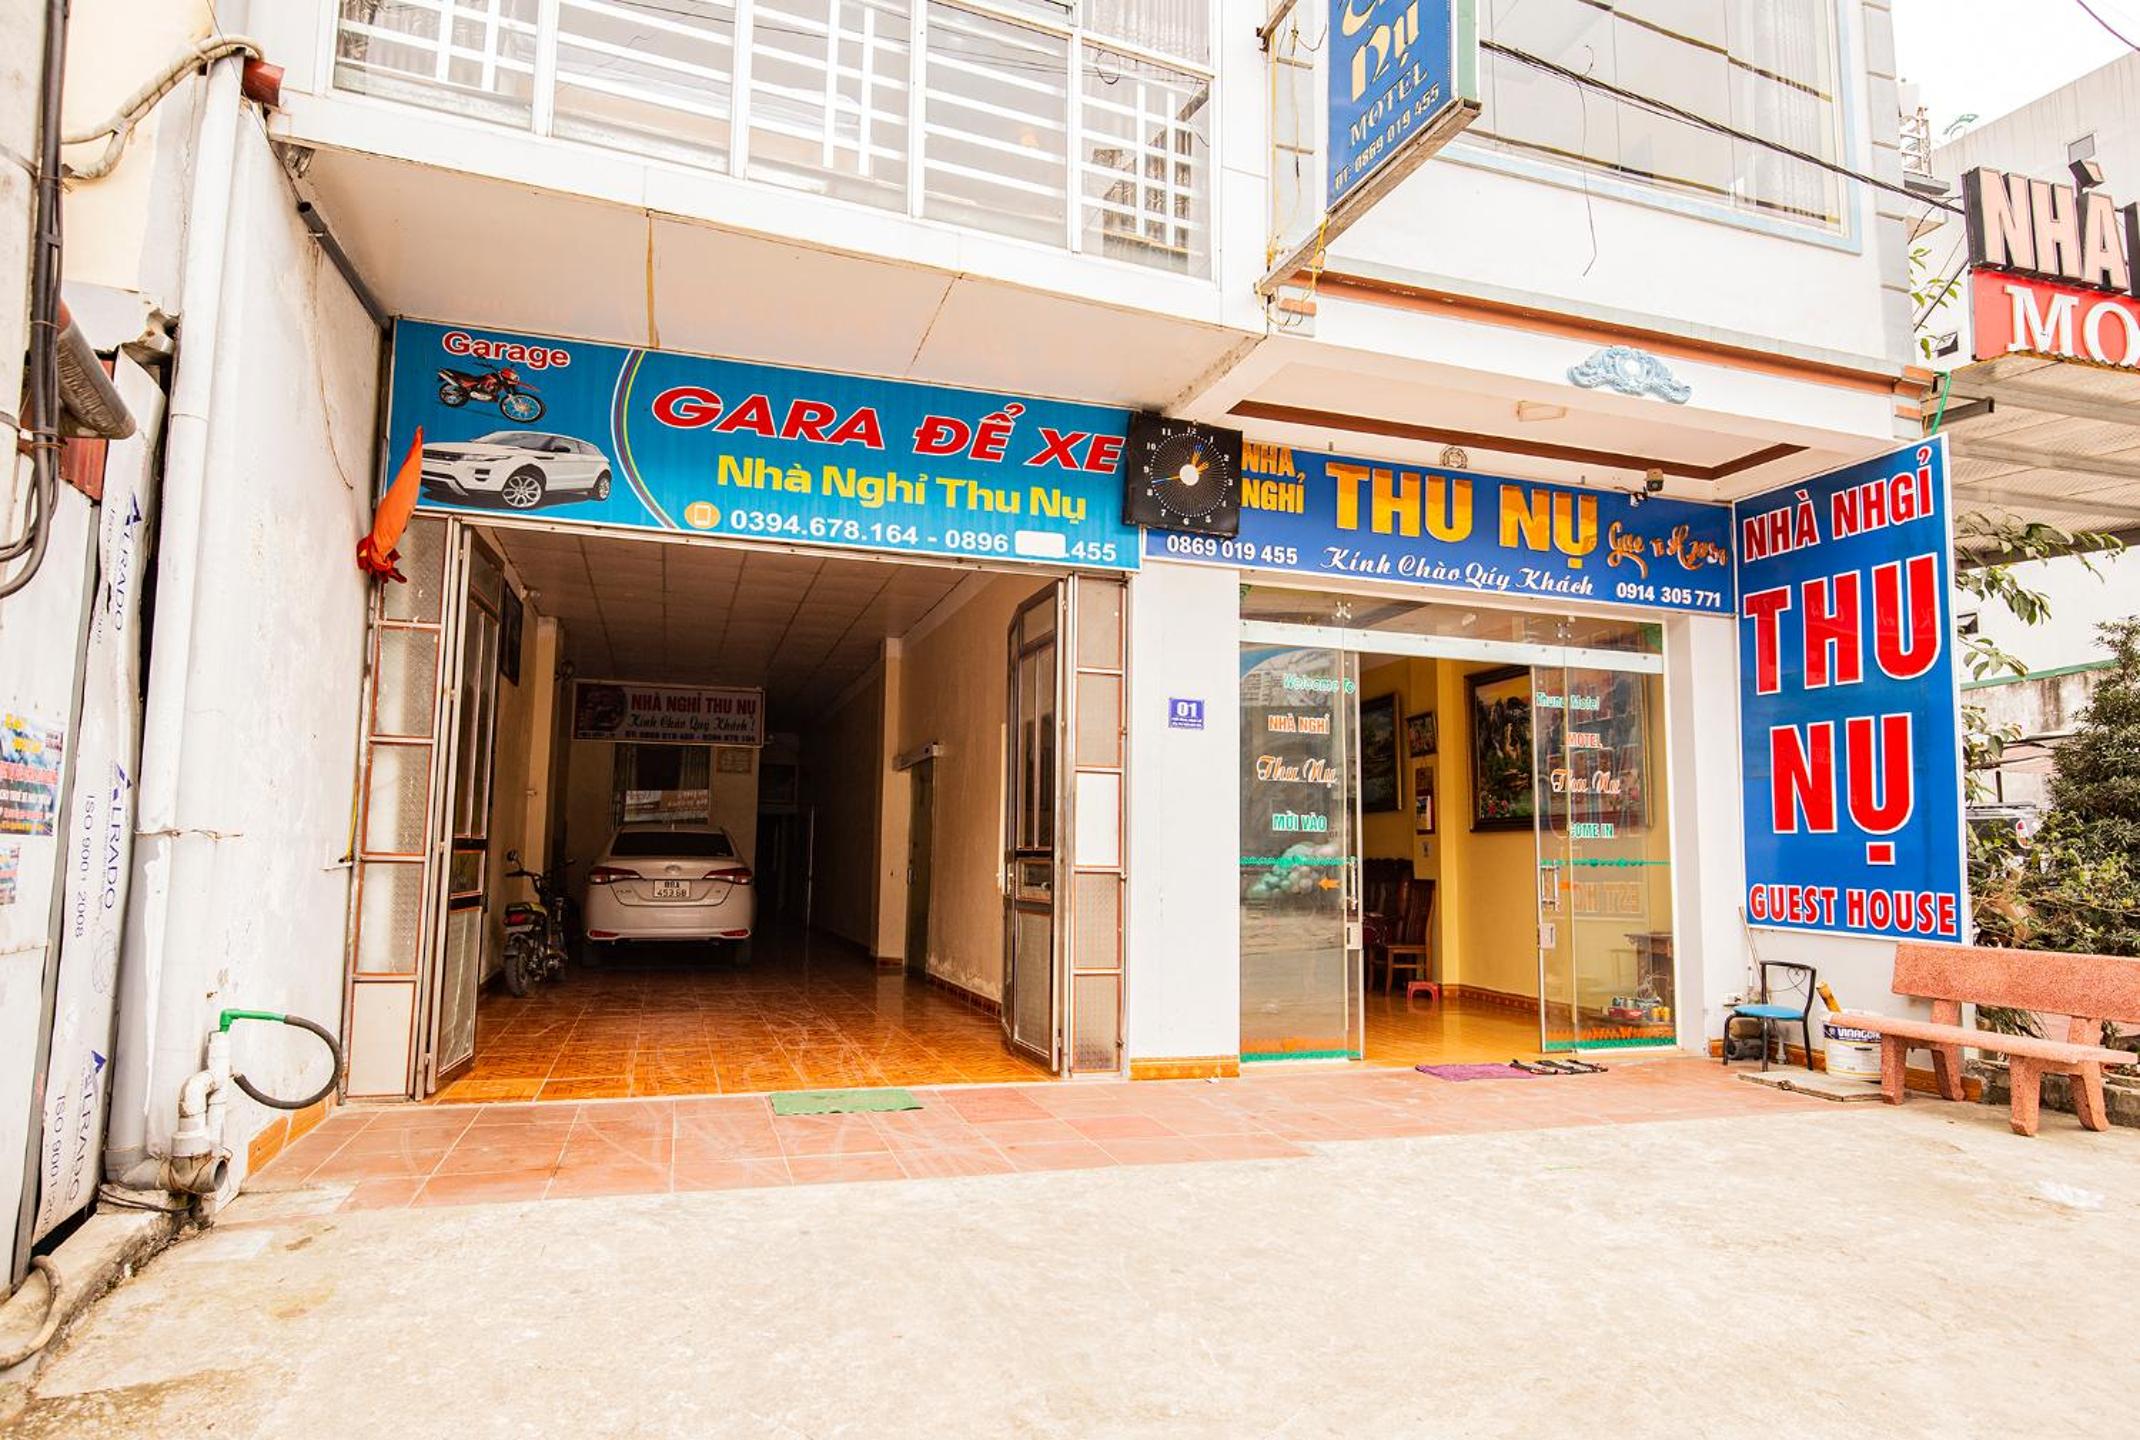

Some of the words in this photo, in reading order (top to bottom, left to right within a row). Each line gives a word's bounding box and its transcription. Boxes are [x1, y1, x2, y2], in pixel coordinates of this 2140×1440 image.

[1349, 60, 1428, 147] MOTEL
[1354, 134, 1384, 173] 0869
[1386, 109, 1411, 144] 019
[1413, 82, 1440, 116] 455
[1963, 159, 2130, 291] NHÀ
[442, 330, 571, 371] Garage
[651, 385, 885, 450] GARA
[912, 402, 1026, 463] ĐỂ
[1024, 427, 1127, 474] XE
[717, 454, 812, 493] Nhà
[822, 463, 928, 508] Nghỉ
[935, 476, 1020, 514] Thu
[1029, 485, 1088, 526] Nụ
[1241, 471, 1306, 515] NGHỈ
[1743, 489, 1819, 563] NHÀ
[1831, 446, 1936, 540] NHGỈ
[730, 509, 919, 546] 0394.678.164
[944, 529, 1009, 553] 0896
[1325, 460, 1473, 543] THU
[1499, 484, 1598, 569] NỤ
[1166, 535, 1217, 556] 0869
[1222, 538, 1255, 561] 019
[1261, 544, 1298, 565] 455
[1320, 546, 1392, 576] Kính
[1398, 554, 1461, 583] Chào
[1514, 567, 1595, 596] Khách
[1616, 582, 1656, 602] 0914
[1660, 586, 1692, 605] 305
[1695, 589, 1722, 608] 771
[1743, 551, 1943, 697] THU
[1176, 701, 1198, 718] 01
[1267, 712, 1297, 733] NHÀ
[1256, 755, 1300, 782] Thu
[1769, 712, 1916, 867] NỤ
[83, 795, 95, 830] ISO
[1599, 823, 1615, 839] IN
[1750, 883, 1838, 927] GUEST
[1847, 887, 1957, 937] HOUSE
[53, 1096, 66, 1133] ISO
